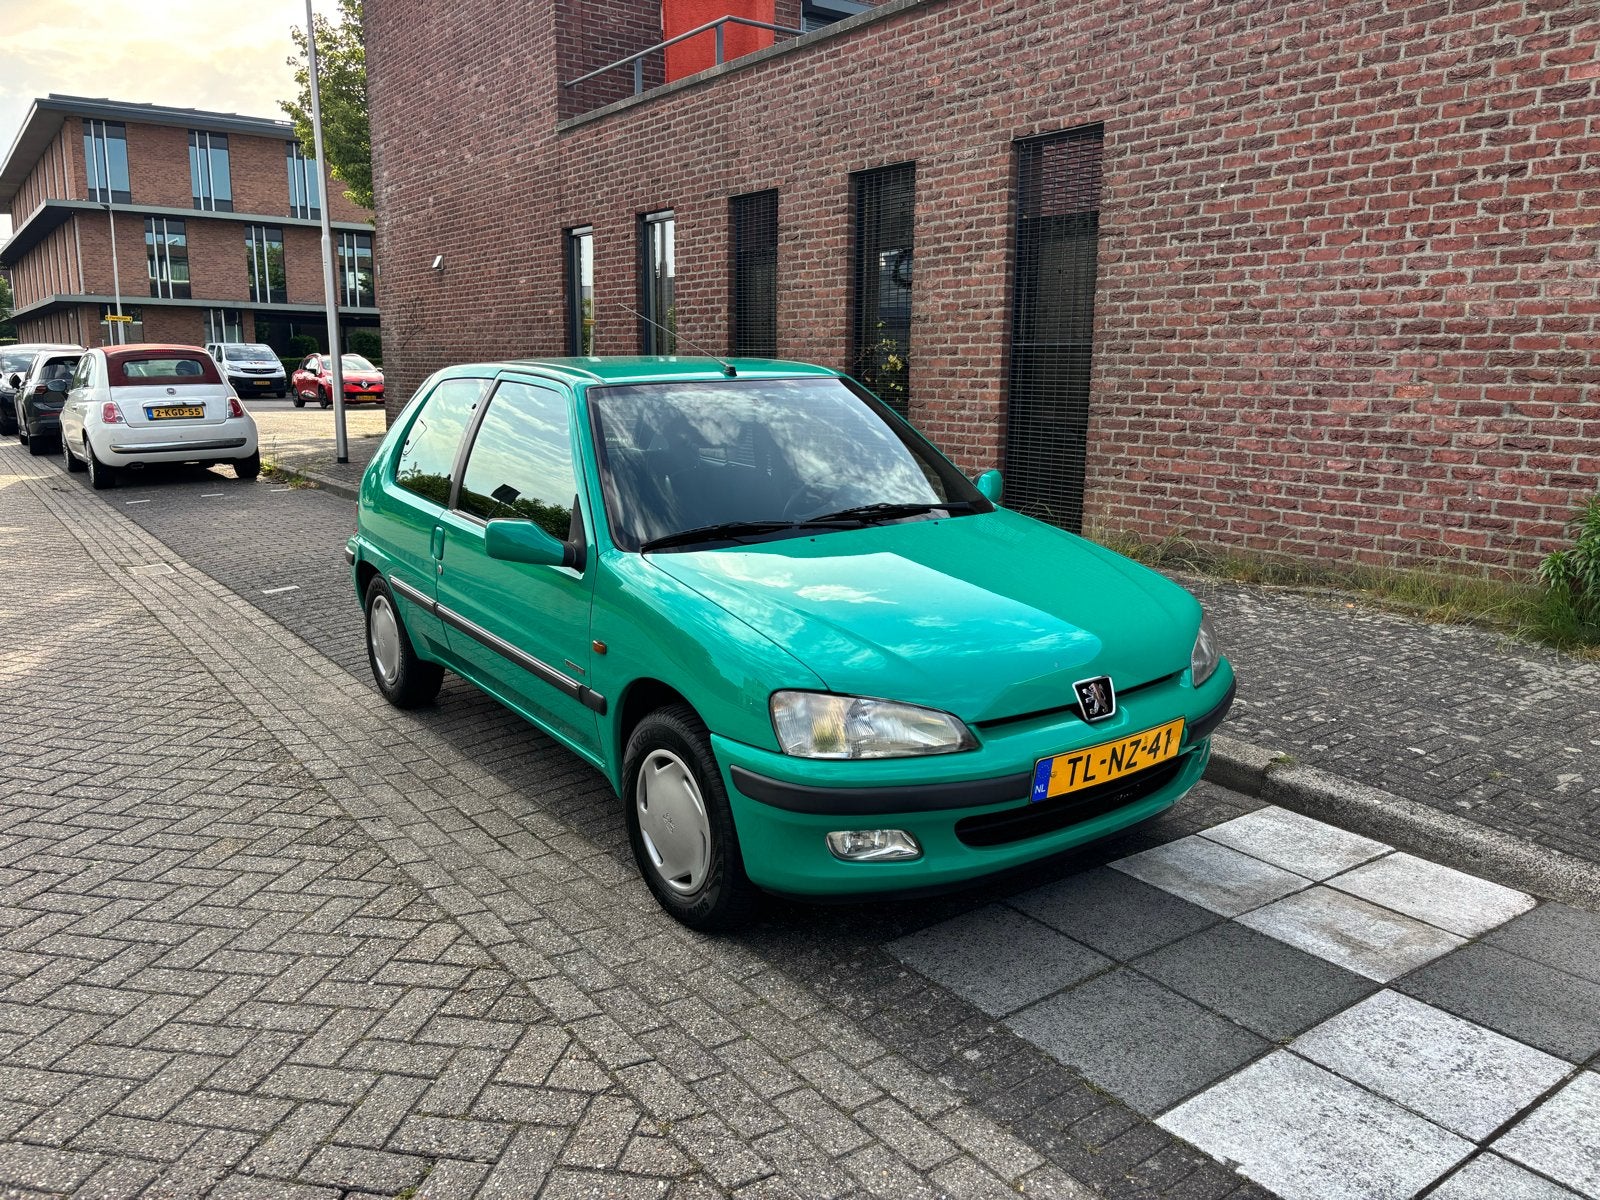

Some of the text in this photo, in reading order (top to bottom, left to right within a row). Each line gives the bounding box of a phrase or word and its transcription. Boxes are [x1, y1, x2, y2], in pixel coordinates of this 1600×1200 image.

[155, 408, 201, 417] 2-KGD-55
[1067, 728, 1173, 786] TL-NZ-41
[1034, 784, 1046, 794] NL
